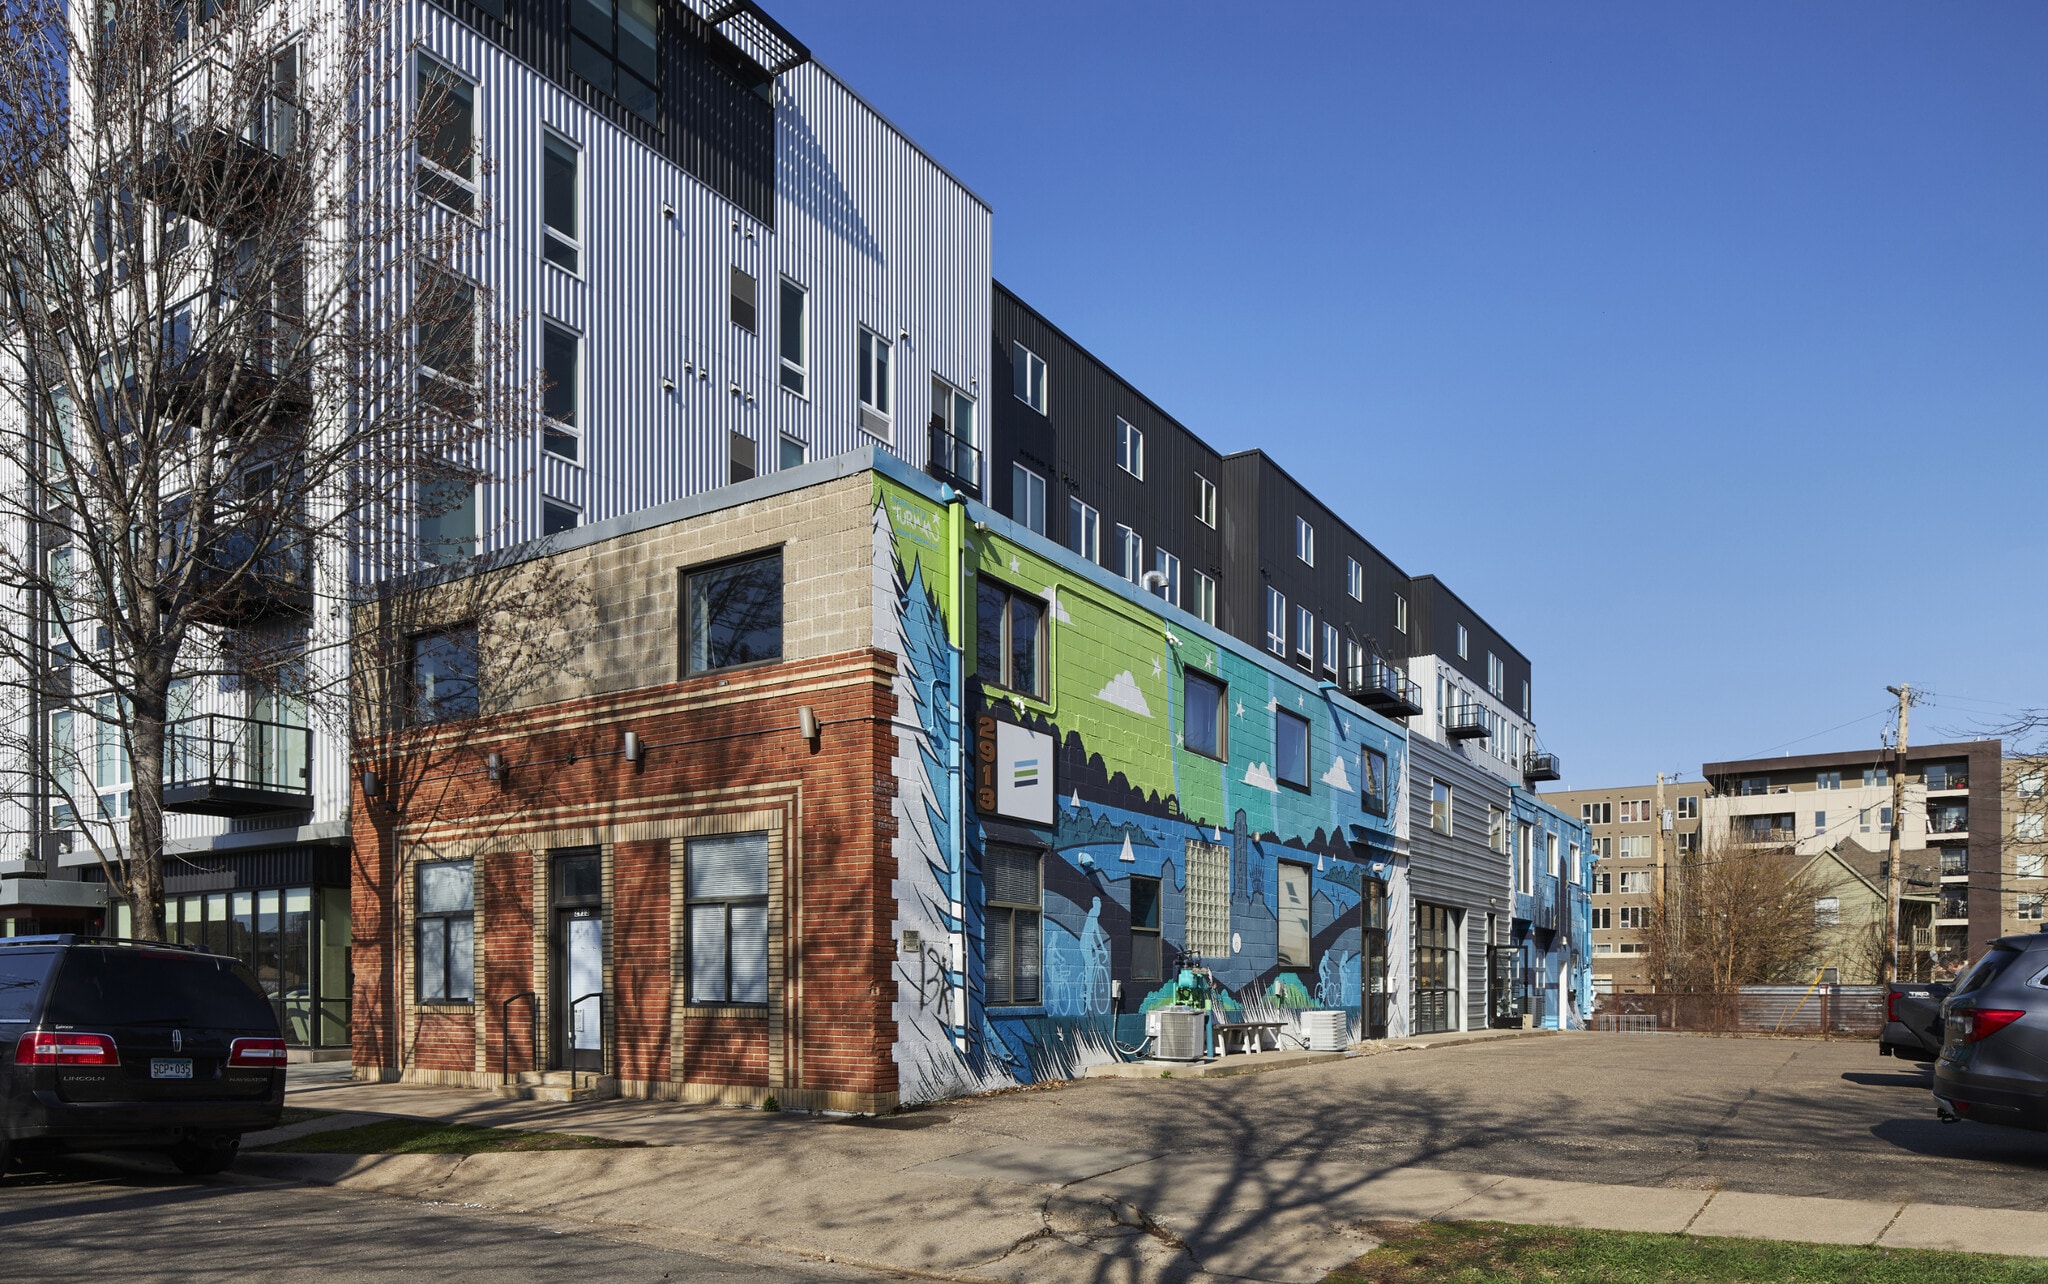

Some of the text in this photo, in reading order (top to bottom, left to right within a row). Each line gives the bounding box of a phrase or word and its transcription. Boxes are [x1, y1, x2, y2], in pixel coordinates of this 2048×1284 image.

[979, 716, 996, 811] 2913
[153, 1063, 191, 1074] SCP 035
